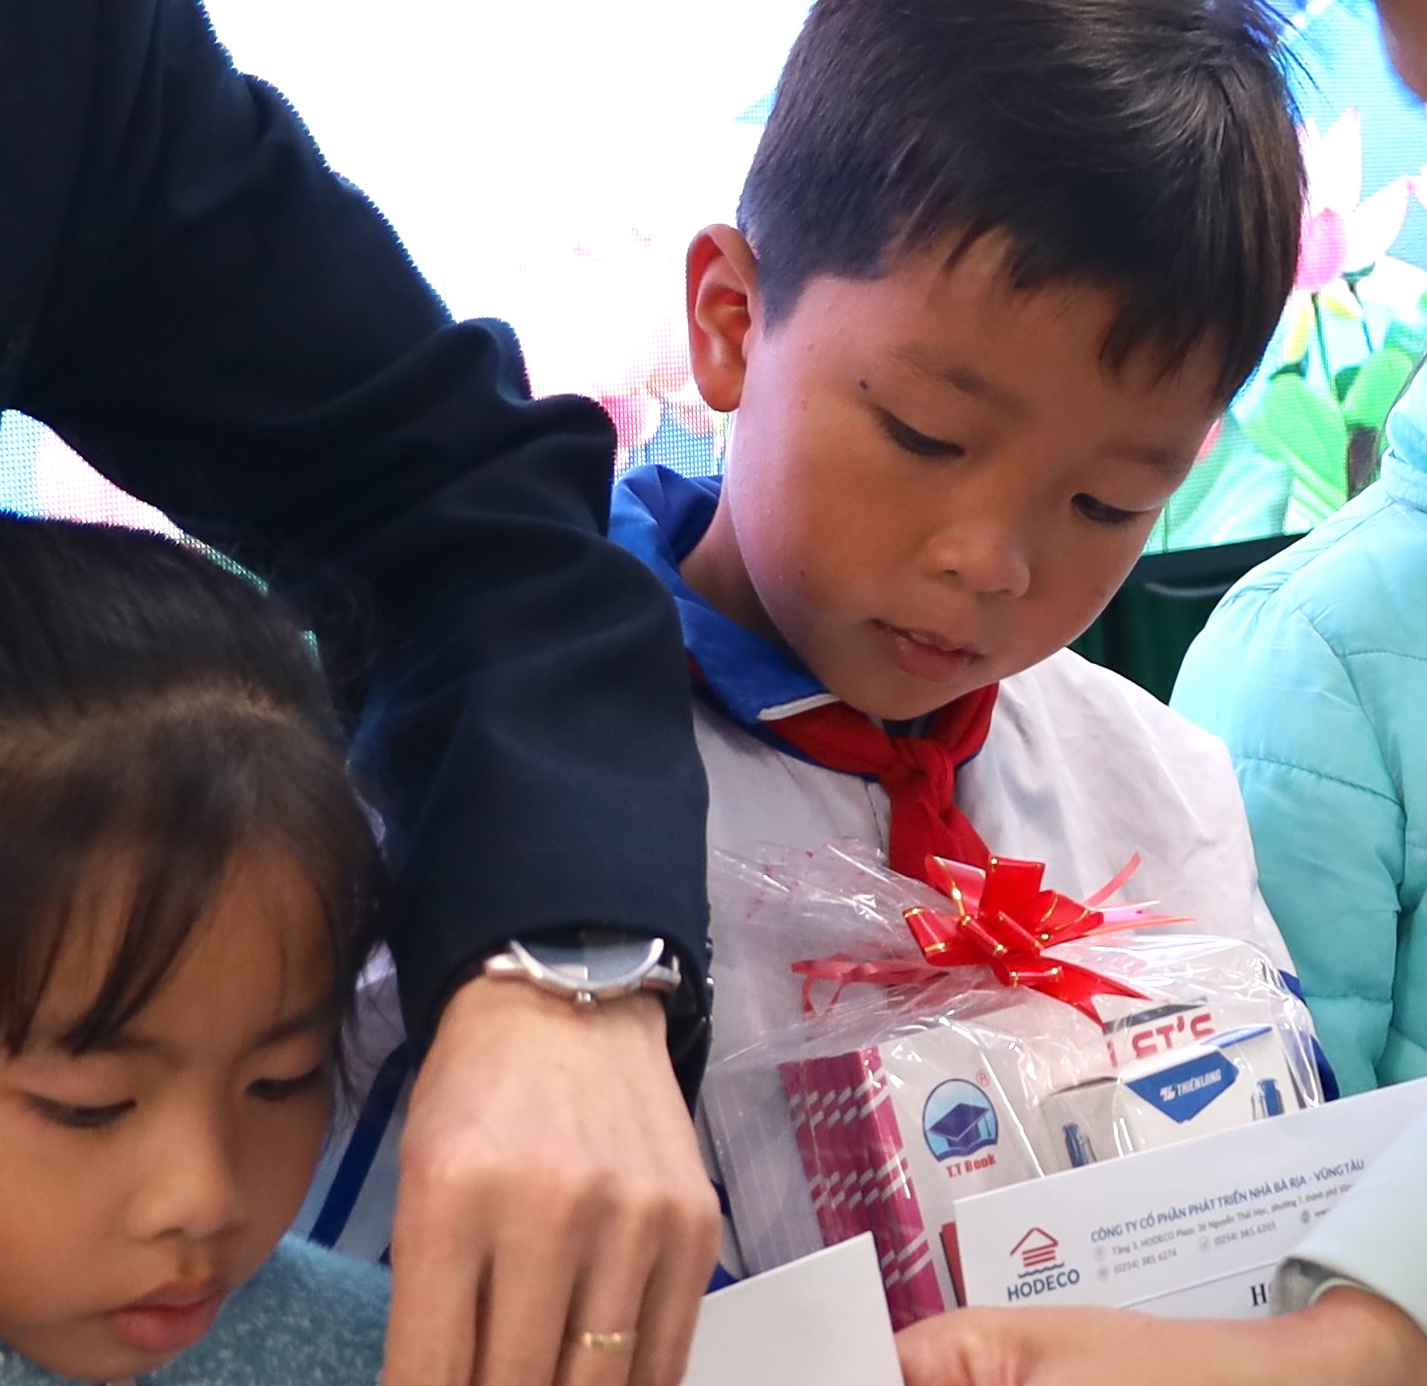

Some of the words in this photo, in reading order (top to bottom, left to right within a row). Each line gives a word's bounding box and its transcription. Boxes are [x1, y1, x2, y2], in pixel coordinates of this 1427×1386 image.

[964, 1154, 998, 1175] Book
[1090, 1225, 1124, 1244] CÔNG
[1125, 1219, 1138, 1234] TY
[1007, 1266, 1081, 1303] HODECO
